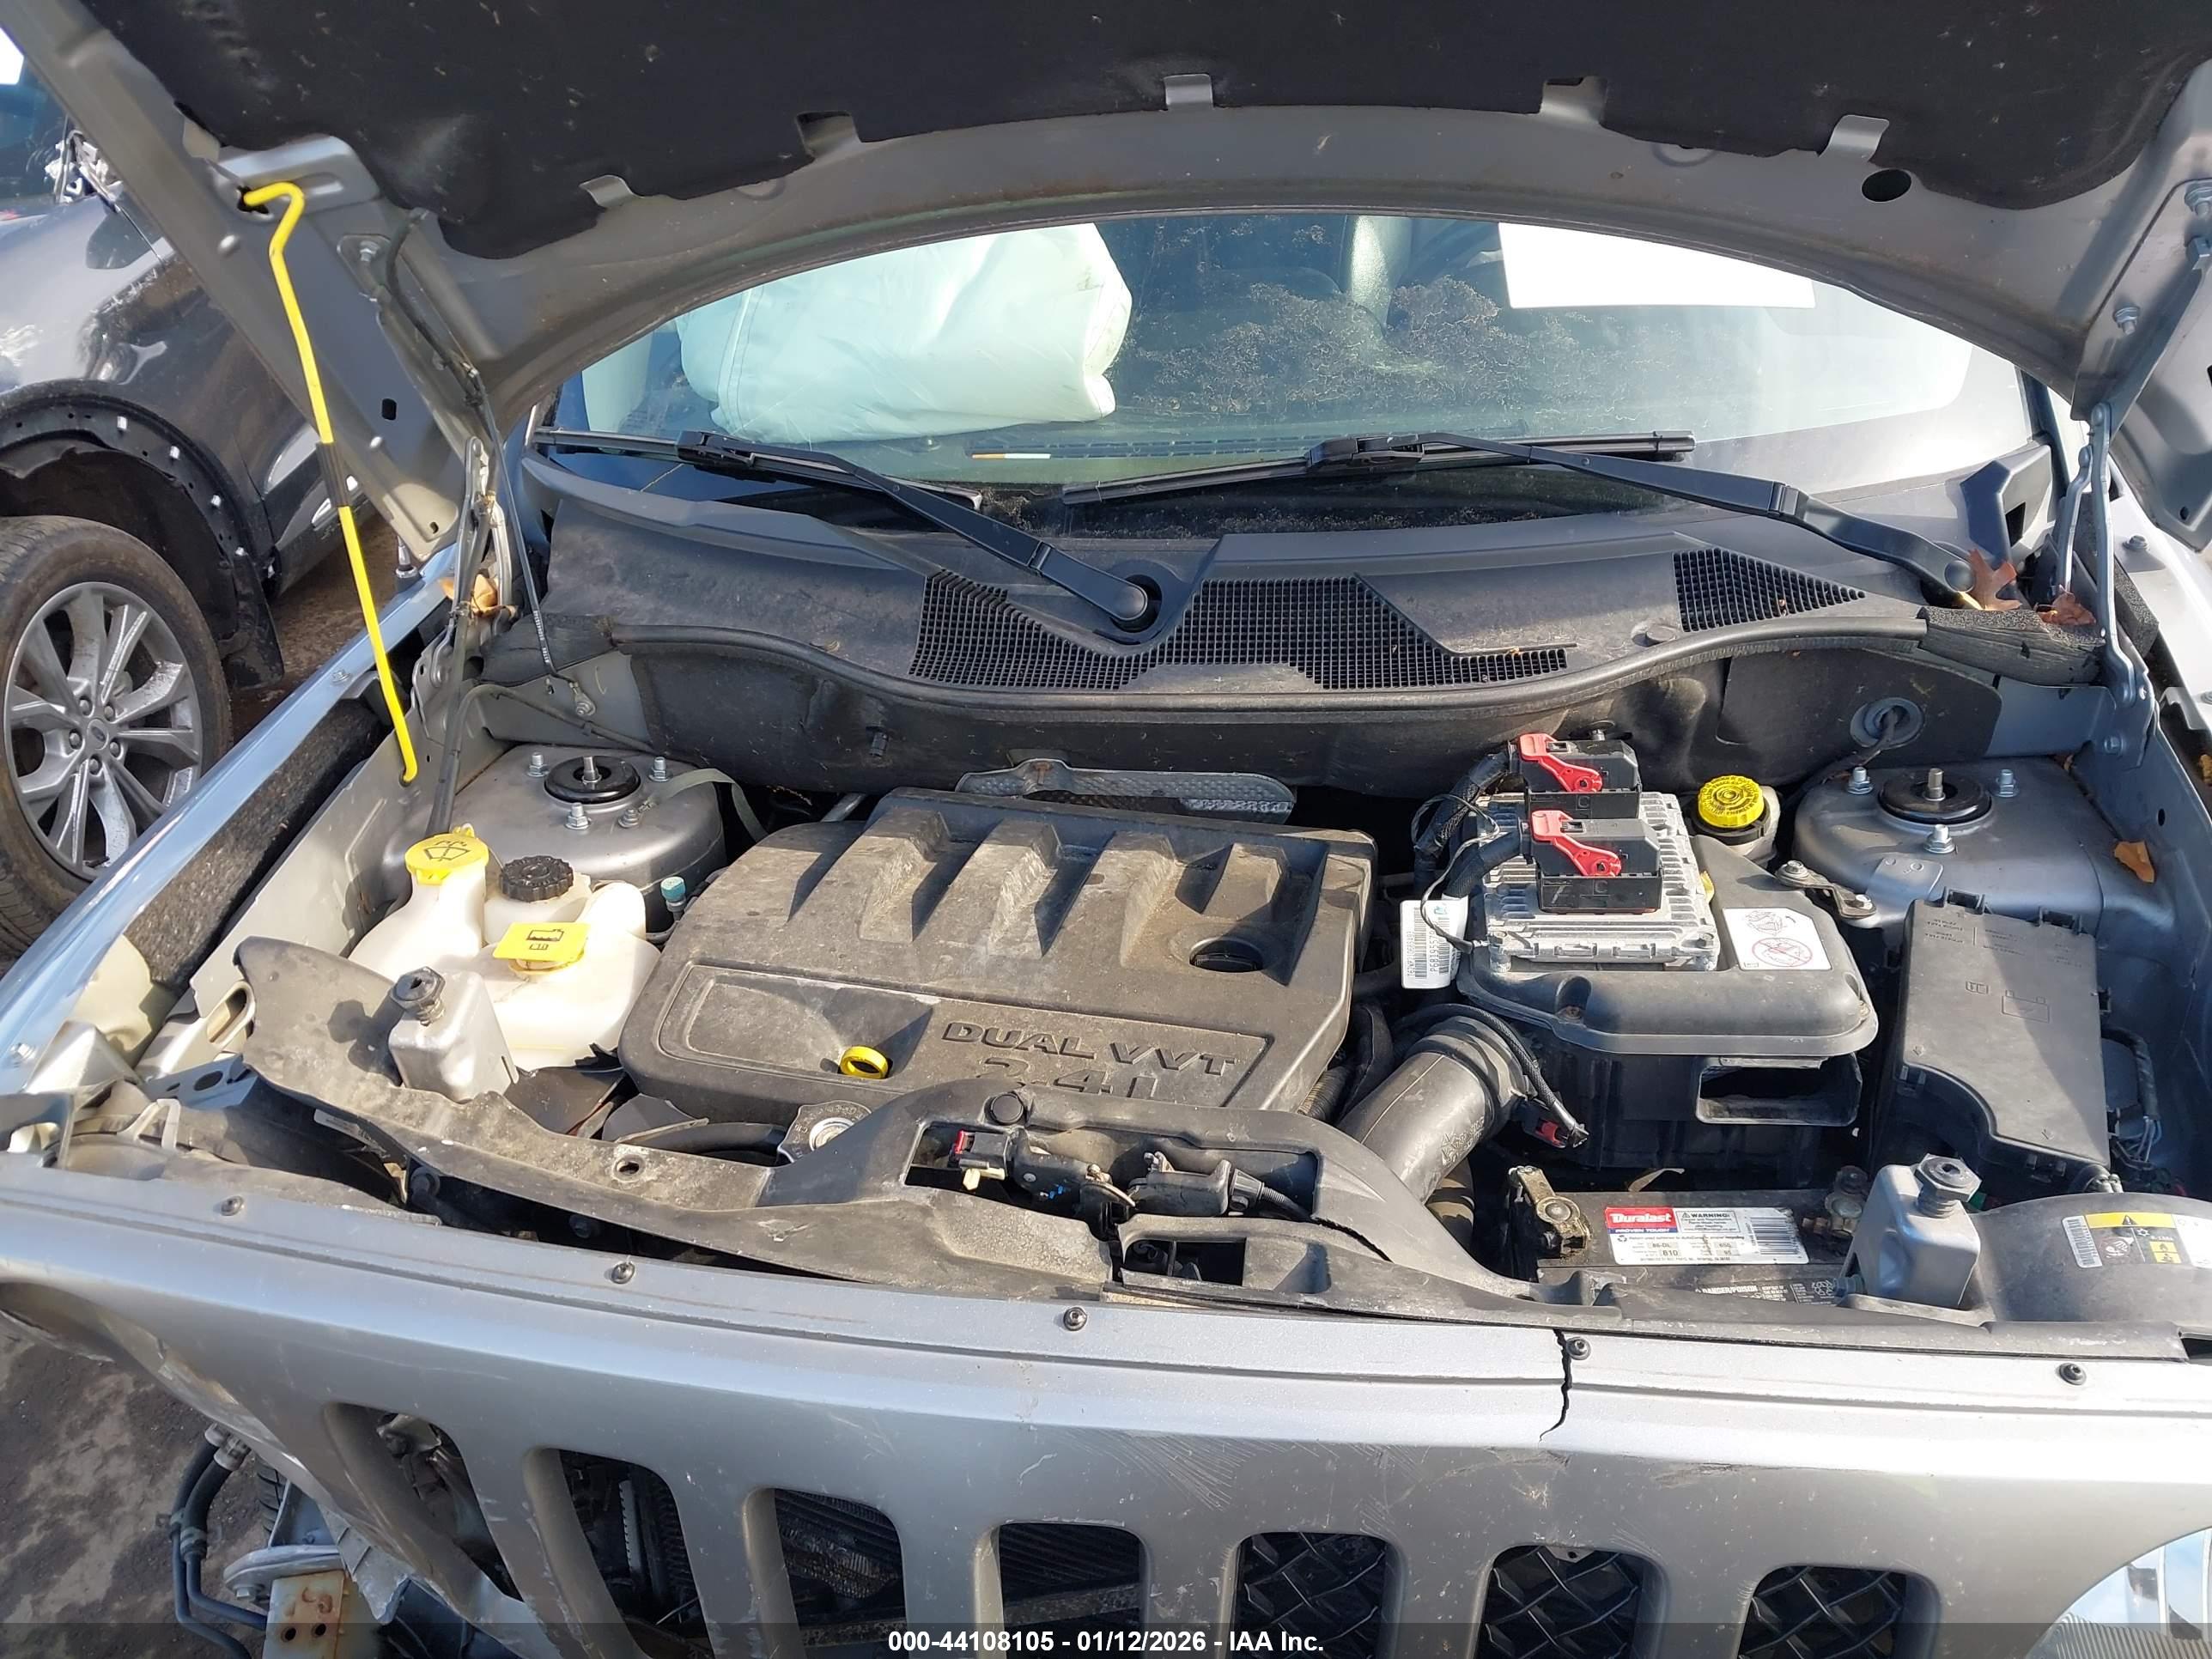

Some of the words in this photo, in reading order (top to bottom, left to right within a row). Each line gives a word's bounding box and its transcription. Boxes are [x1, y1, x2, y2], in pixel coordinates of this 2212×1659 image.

[941, 1022, 1097, 1060] DUAL
[1109, 1042, 1237, 1076] VVT
[1609, 1212, 1671, 1223] Duralast
[1702, 1285, 1759, 1294] DANGER/POISON
